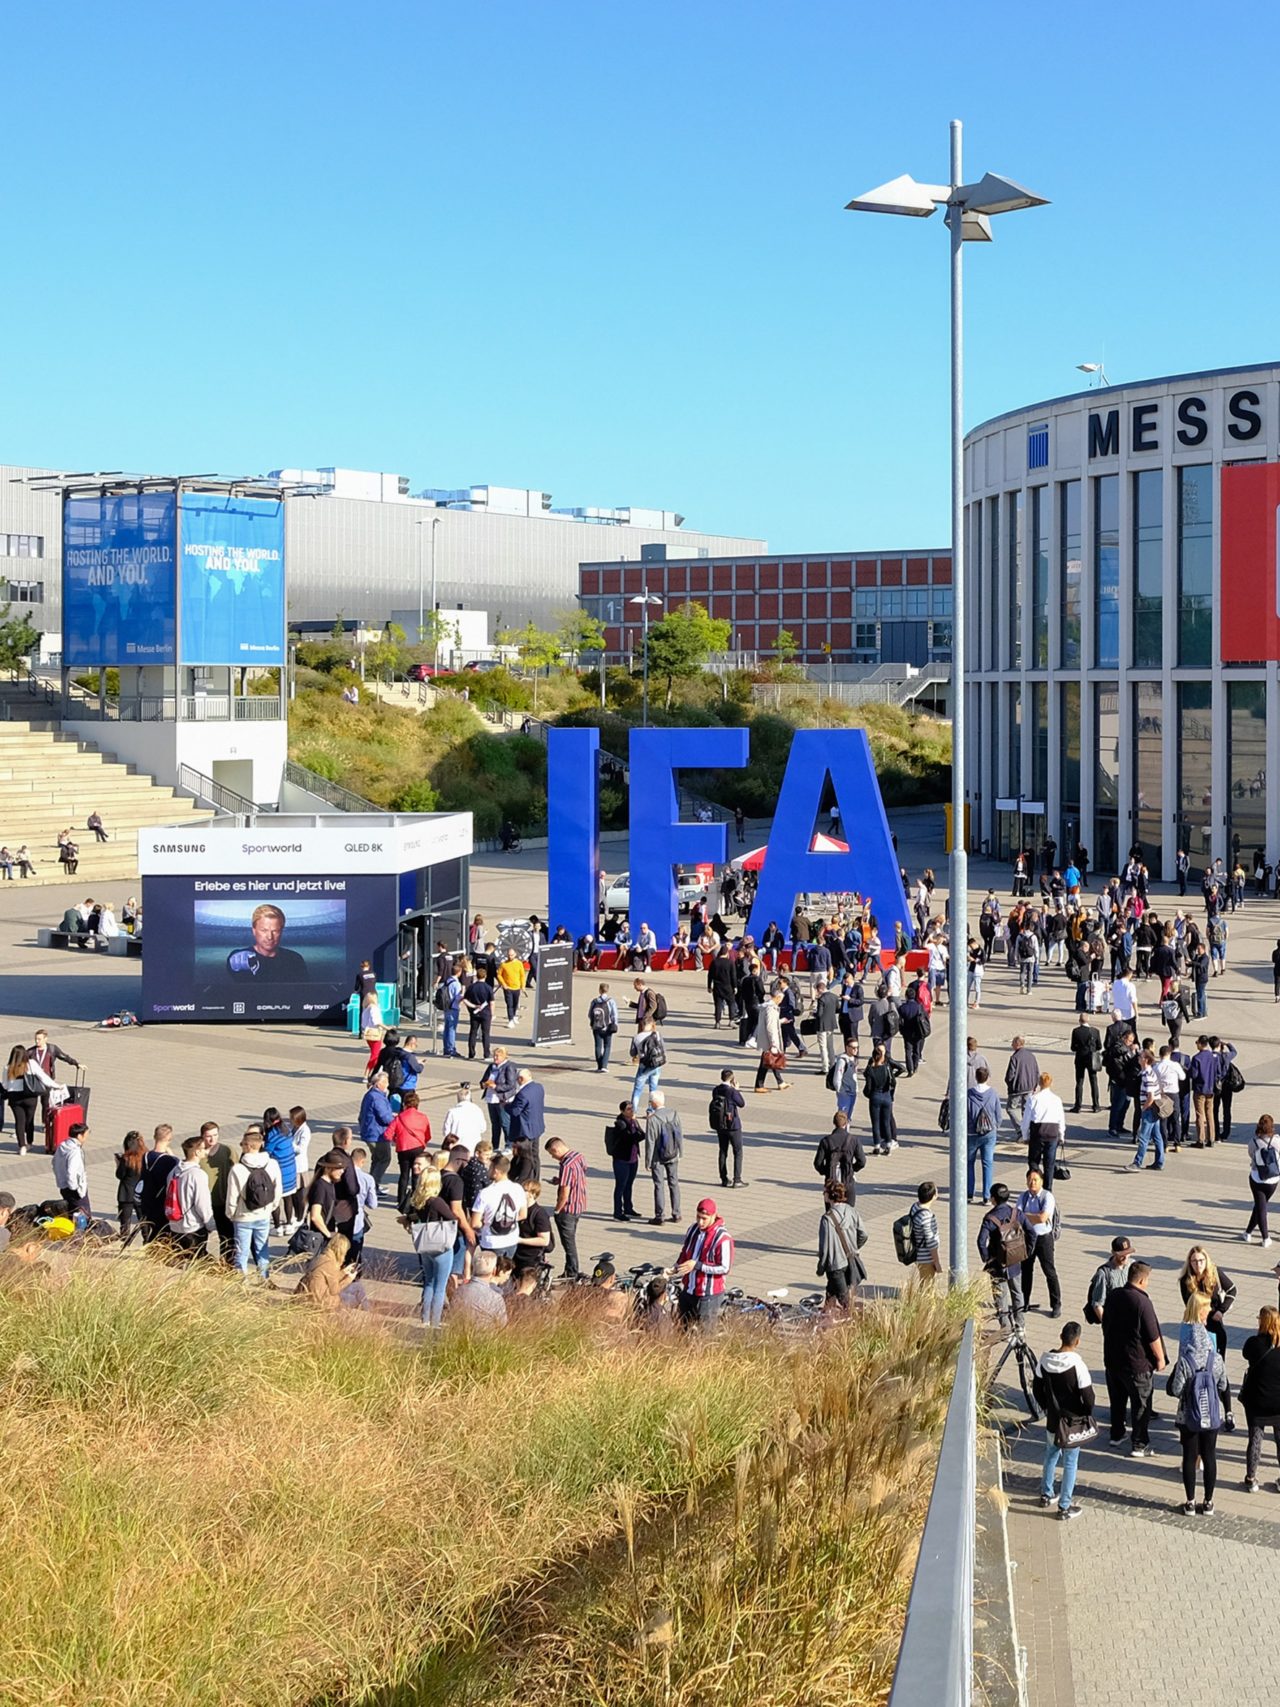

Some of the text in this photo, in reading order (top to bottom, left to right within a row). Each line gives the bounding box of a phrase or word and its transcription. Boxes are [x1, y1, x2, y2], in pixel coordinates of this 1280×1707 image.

[67, 546, 173, 567] HOSTING THE WORLD.
[184, 543, 281, 561] HOSTING THE WORLD.
[205, 556, 231, 571] AND
[88, 564, 148, 586] AND YOU.
[547, 727, 915, 950] IFA
[153, 844, 206, 853] SAMSUNG
[344, 843, 370, 852] QLED
[371, 843, 383, 852] 8K
[195, 880, 346, 893] Erlebe es hier und jetzt live!
